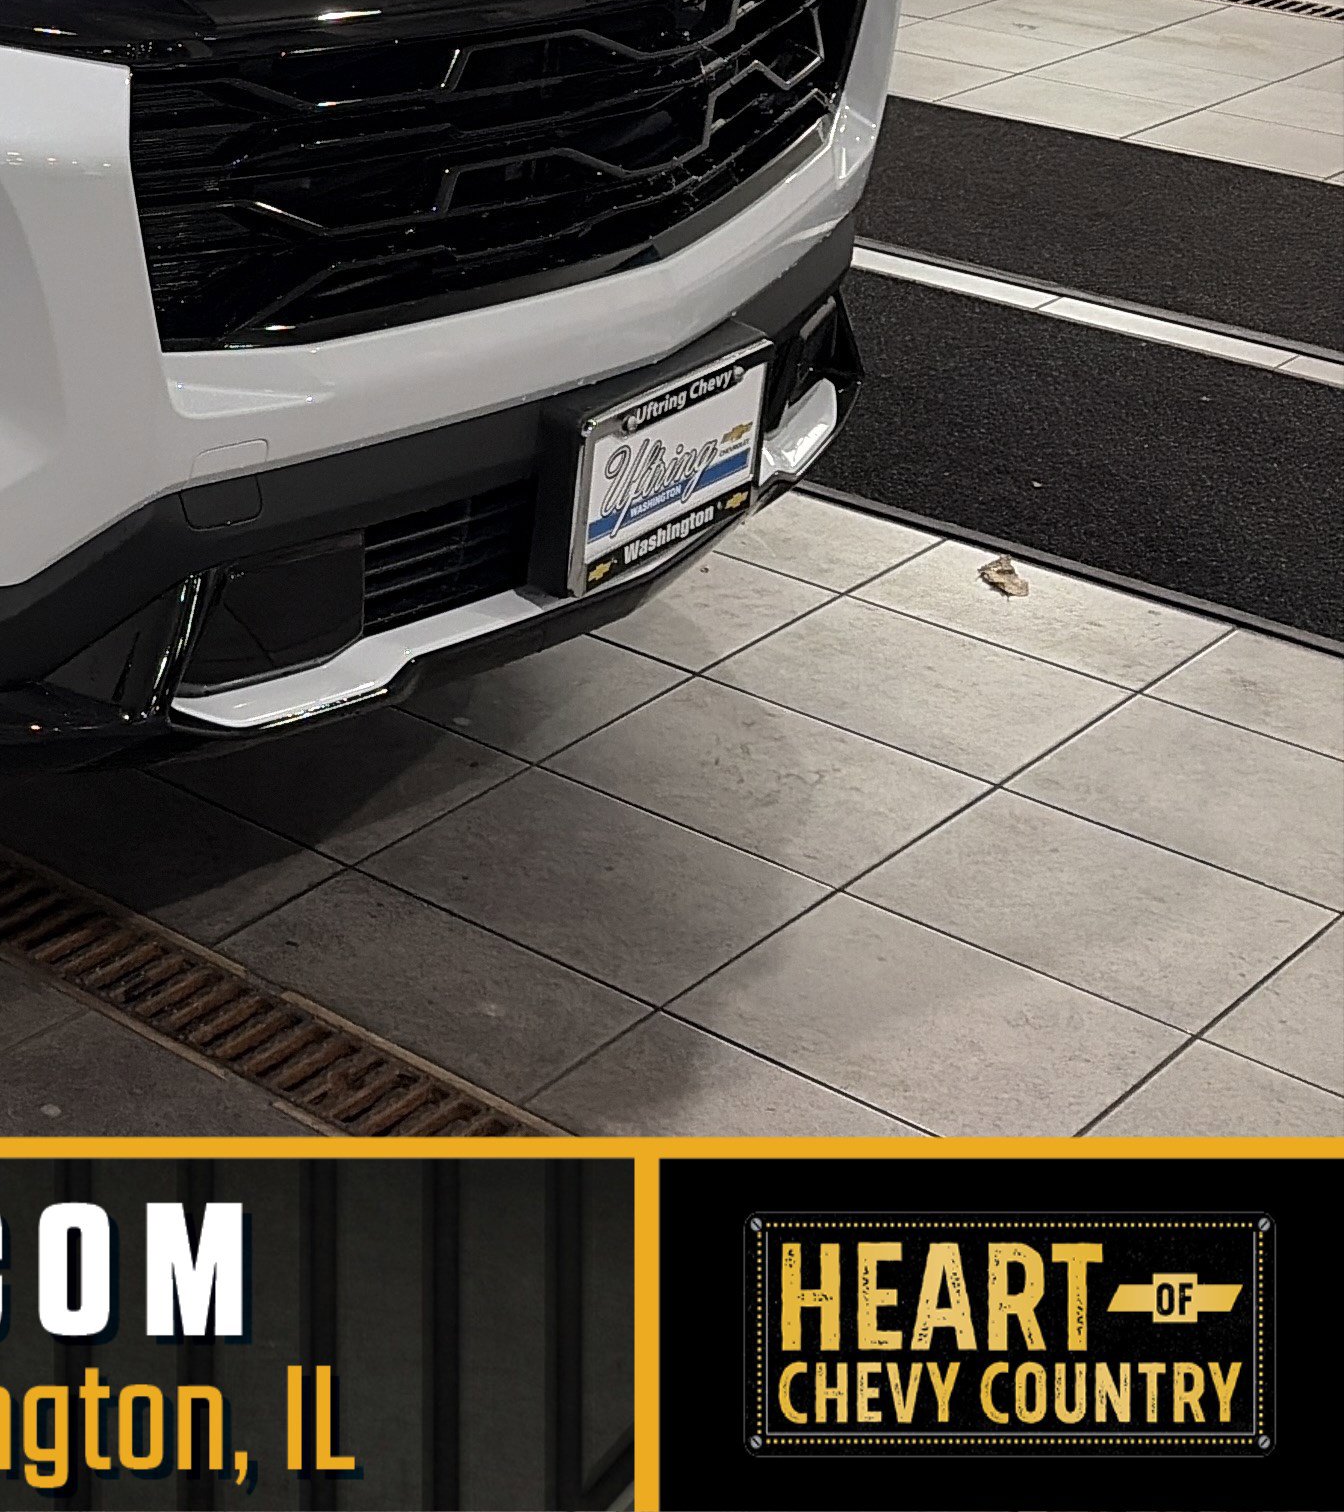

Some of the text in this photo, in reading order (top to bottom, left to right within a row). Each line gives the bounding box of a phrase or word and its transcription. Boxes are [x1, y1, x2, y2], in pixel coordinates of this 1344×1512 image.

[635, 369, 733, 423] Uftring Chevy
[719, 440, 750, 456] CHEVROLET
[630, 484, 682, 518] WASHINGTON
[624, 505, 714, 564] Washington
